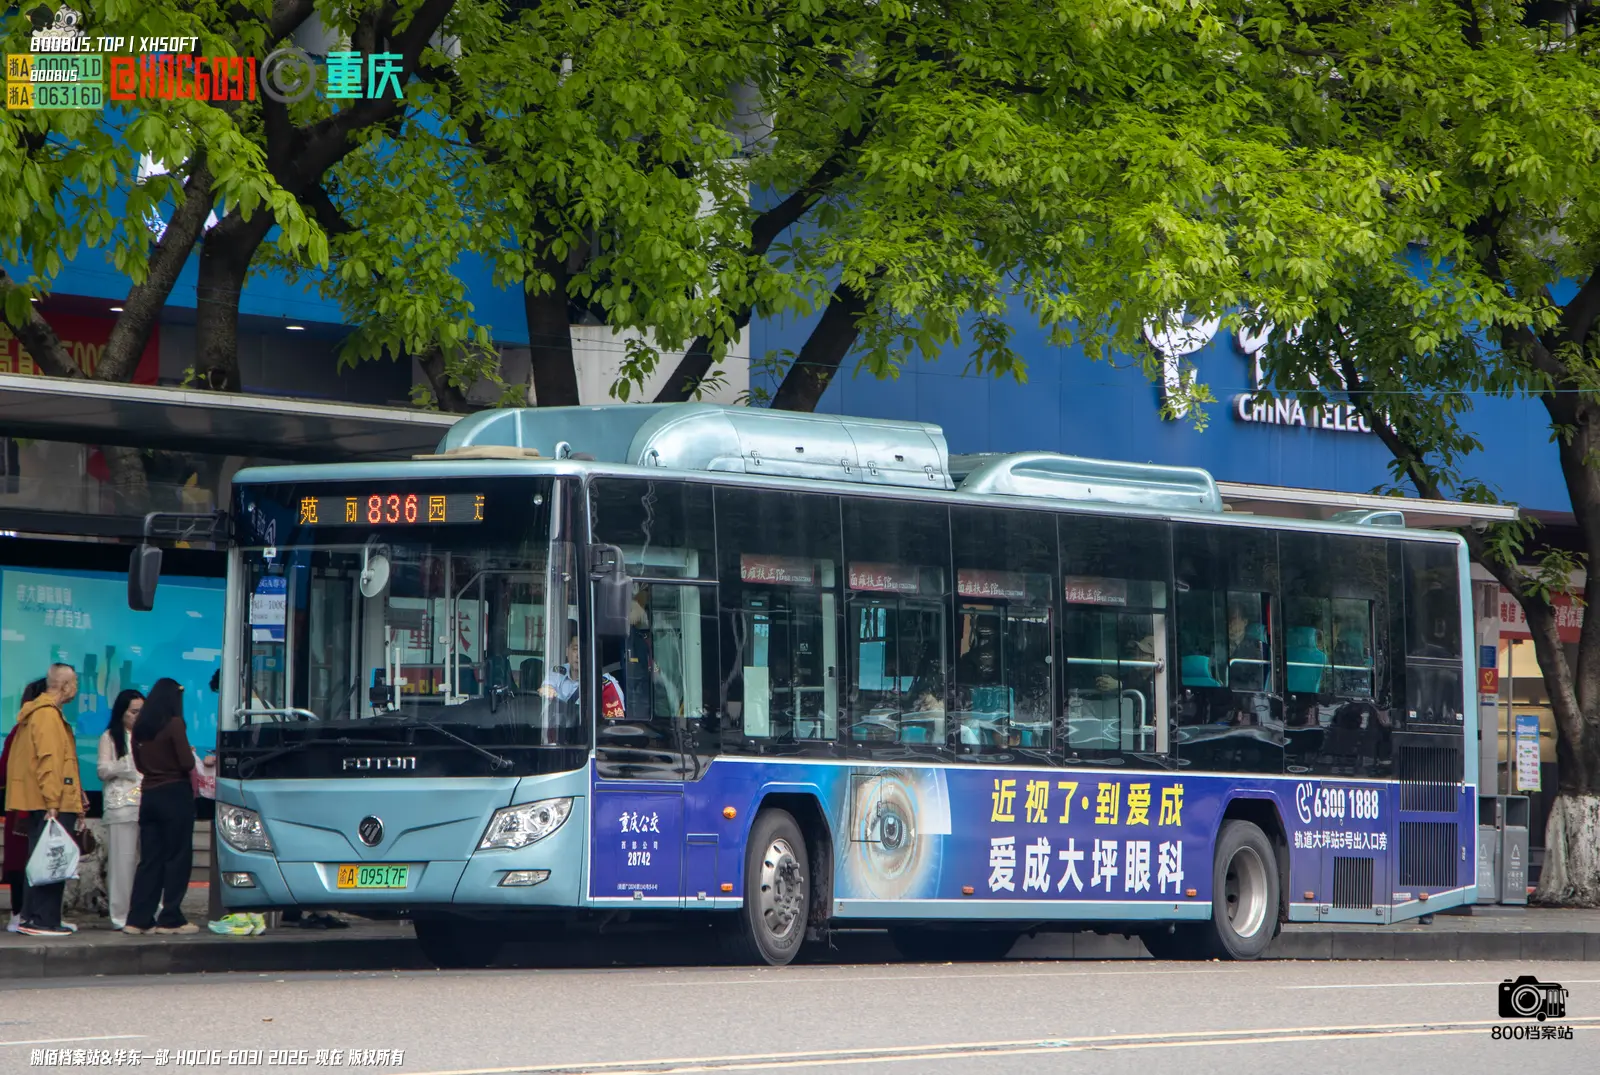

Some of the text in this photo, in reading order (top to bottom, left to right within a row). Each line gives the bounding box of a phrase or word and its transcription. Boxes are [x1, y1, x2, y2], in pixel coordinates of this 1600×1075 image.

[1236, 393, 1307, 427] CHINA
[367, 494, 418, 524] 836
[428, 495, 446, 523] 园
[342, 756, 416, 770] FOTON
[1314, 788, 1379, 820] 6300 1888
[618, 811, 660, 833] 重庆公交
[1294, 830, 1388, 850] 轨道大坪站5号出入口旁
[627, 851, 651, 866] 28742
[988, 836, 1185, 894] 爱成大坪眼科
